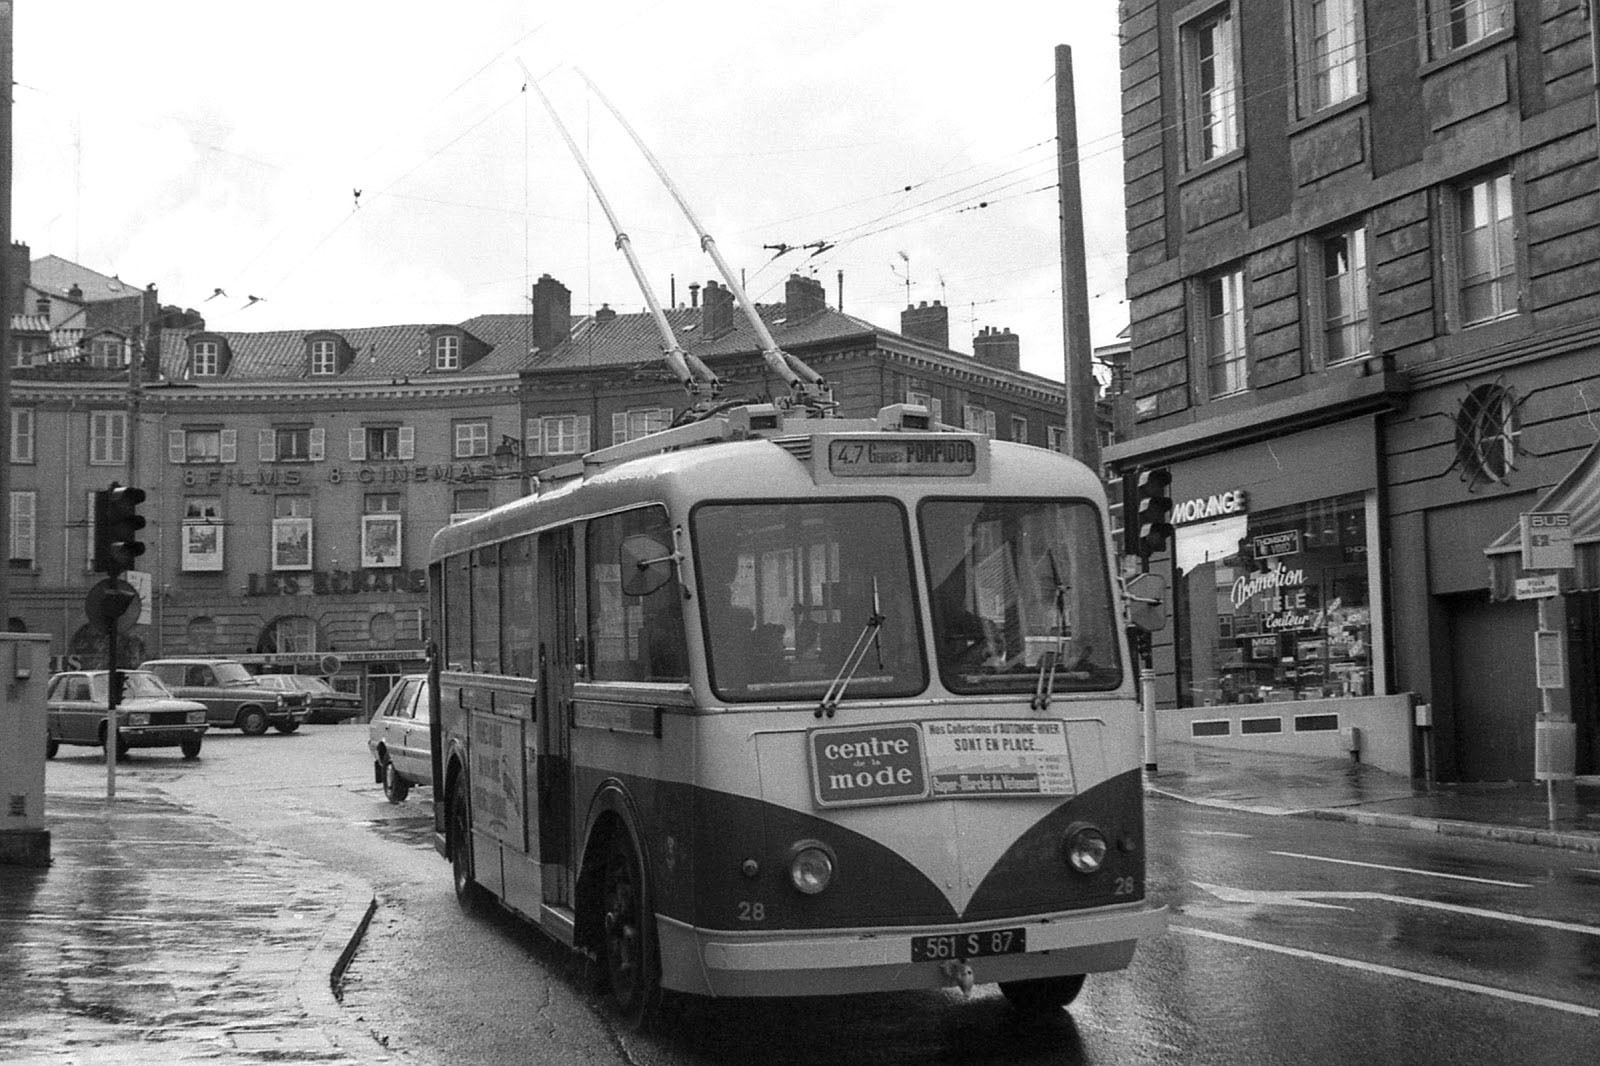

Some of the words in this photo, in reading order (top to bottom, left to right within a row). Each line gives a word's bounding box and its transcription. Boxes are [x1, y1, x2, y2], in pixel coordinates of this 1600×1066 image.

[906, 443, 975, 463] POMPIDOU
[184, 469, 197, 487] 8
[206, 468, 301, 487] FILMS
[329, 467, 342, 485] 8
[1170, 489, 1243, 524] MORANGE
[1532, 515, 1570, 527] BUS
[248, 572, 300, 596] LES
[1230, 562, 1308, 609] Promotion
[929, 725, 946, 735] Nos
[824, 737, 910, 760] centre
[954, 738, 982, 751] SONT
[985, 738, 1000, 751] EN
[829, 766, 913, 789] mode
[1115, 876, 1135, 896] 28
[738, 901, 766, 921] 28
[925, 935, 956, 958] 561
[967, 933, 979, 954] S
[992, 930, 1013, 952] 87
